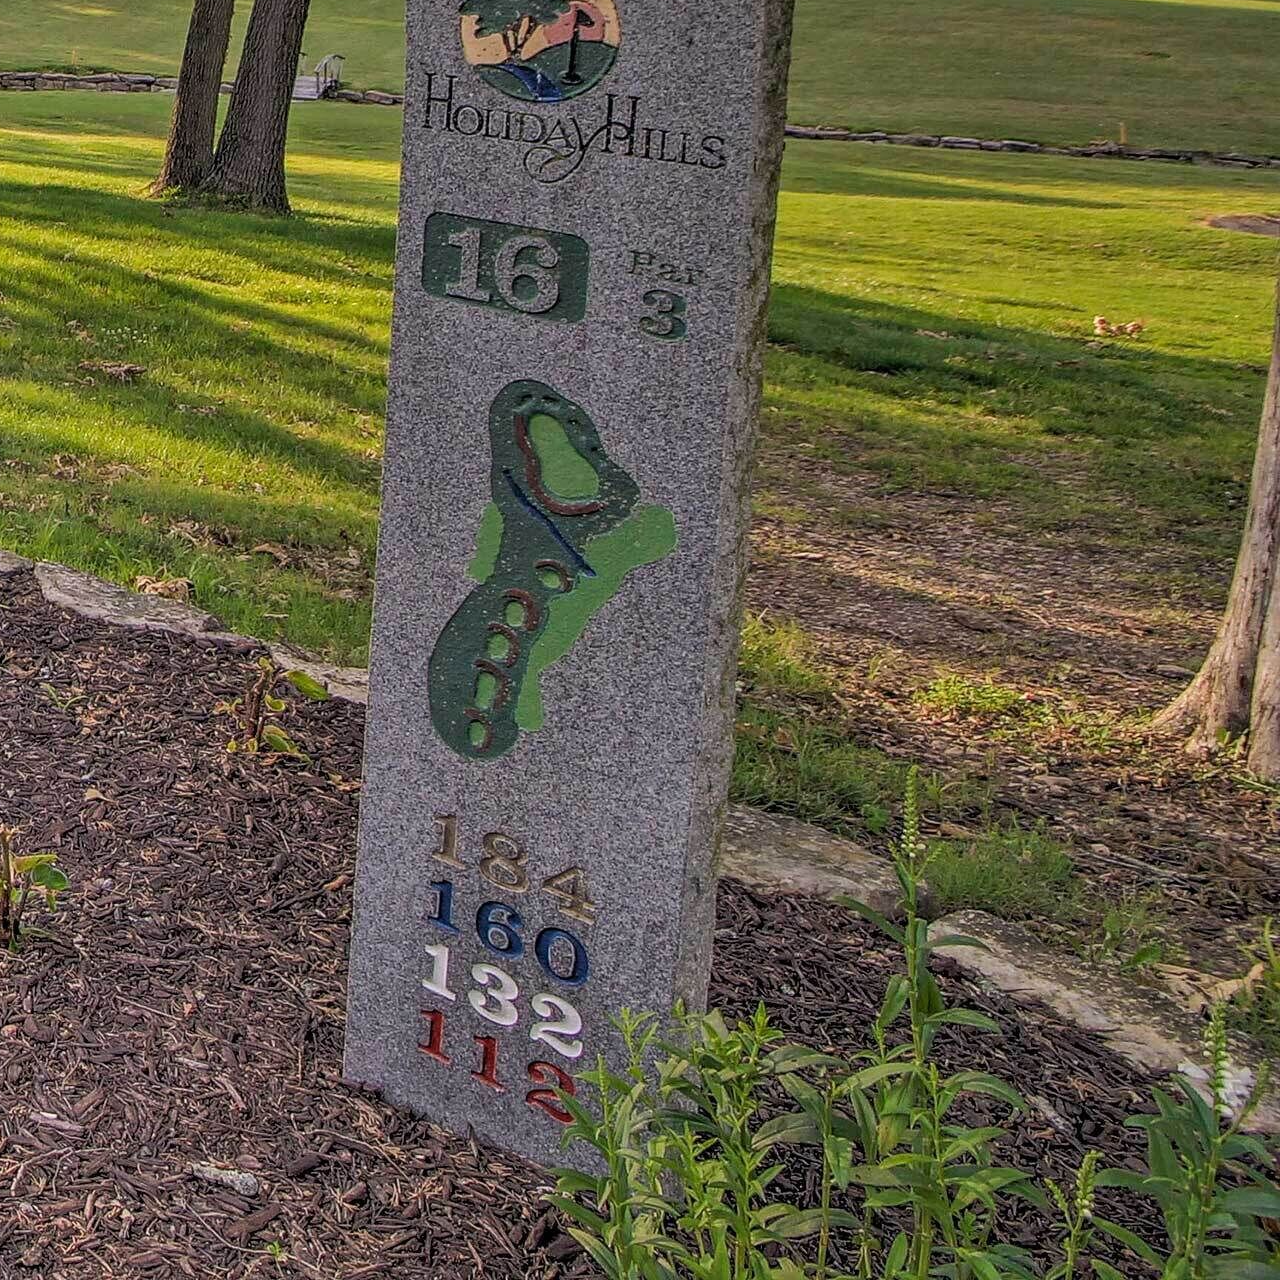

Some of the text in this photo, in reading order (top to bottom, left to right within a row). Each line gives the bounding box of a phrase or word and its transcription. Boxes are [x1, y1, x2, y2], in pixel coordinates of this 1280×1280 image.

[422, 73, 727, 182] HOLIDAY HILLS
[444, 227, 559, 314] 16
[628, 250, 705, 286] Par
[642, 290, 688, 342] 3
[431, 814, 601, 924] 184
[428, 880, 590, 987] 160
[422, 944, 583, 1058] 132
[418, 1008, 576, 1123] 112
